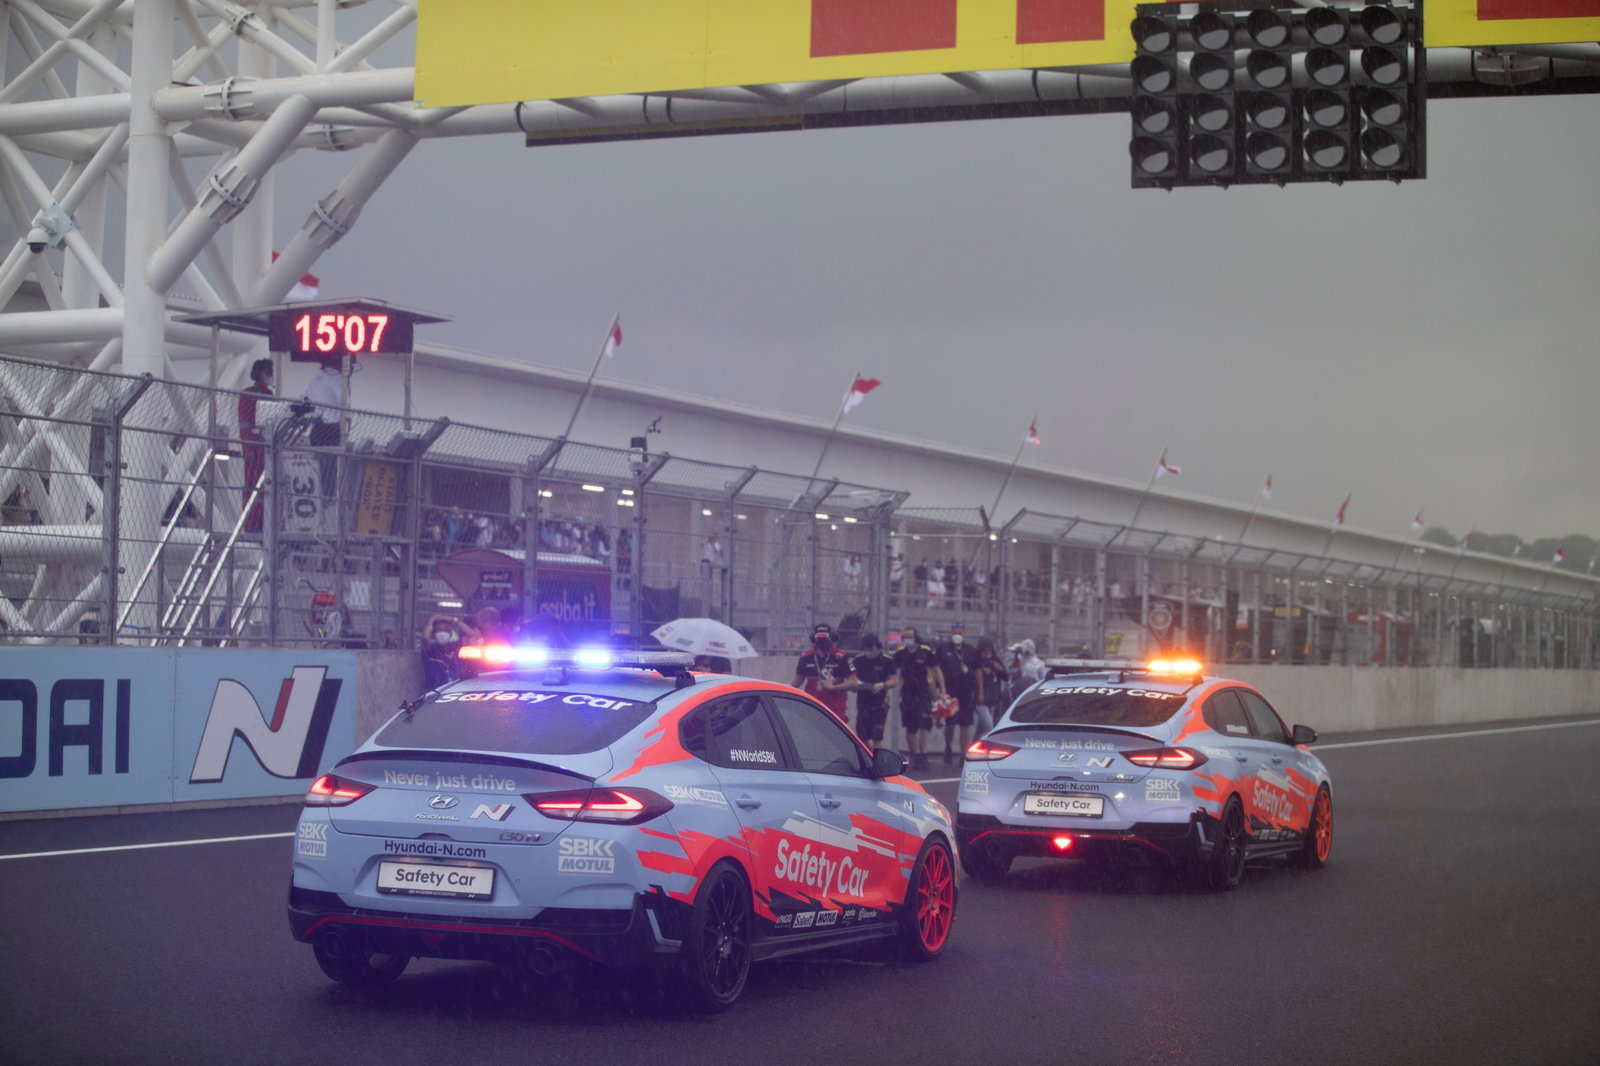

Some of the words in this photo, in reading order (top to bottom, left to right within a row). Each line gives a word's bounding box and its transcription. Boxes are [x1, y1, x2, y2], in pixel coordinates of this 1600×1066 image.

[295, 314, 388, 352] 15'07
[292, 475, 317, 519] 30
[436, 690, 558, 704] Safety
[561, 693, 634, 711] Car
[1040, 686, 1122, 696] Safety
[1126, 689, 1174, 700] Car
[188, 664, 344, 785] N
[1024, 737, 1057, 748] Never
[1060, 738, 1083, 750] just
[1084, 740, 1115, 750] drive
[1085, 756, 1116, 769] N
[383, 769, 430, 786] Never
[434, 772, 468, 790] just
[471, 774, 516, 790] drive
[1030, 780, 1100, 792] Hyundai-N.com
[1036, 798, 1070, 810] Safety
[1072, 800, 1091, 810] Car
[1147, 791, 1179, 800] MOTUL
[1253, 779, 1280, 820] Safety
[469, 802, 517, 821] N
[384, 839, 487, 858] Hyundai-N.com
[560, 857, 612, 872] MOTUL
[774, 838, 837, 898] Safety
[837, 855, 870, 898] Car
[395, 868, 445, 887] Safety
[447, 871, 476, 886] Car
